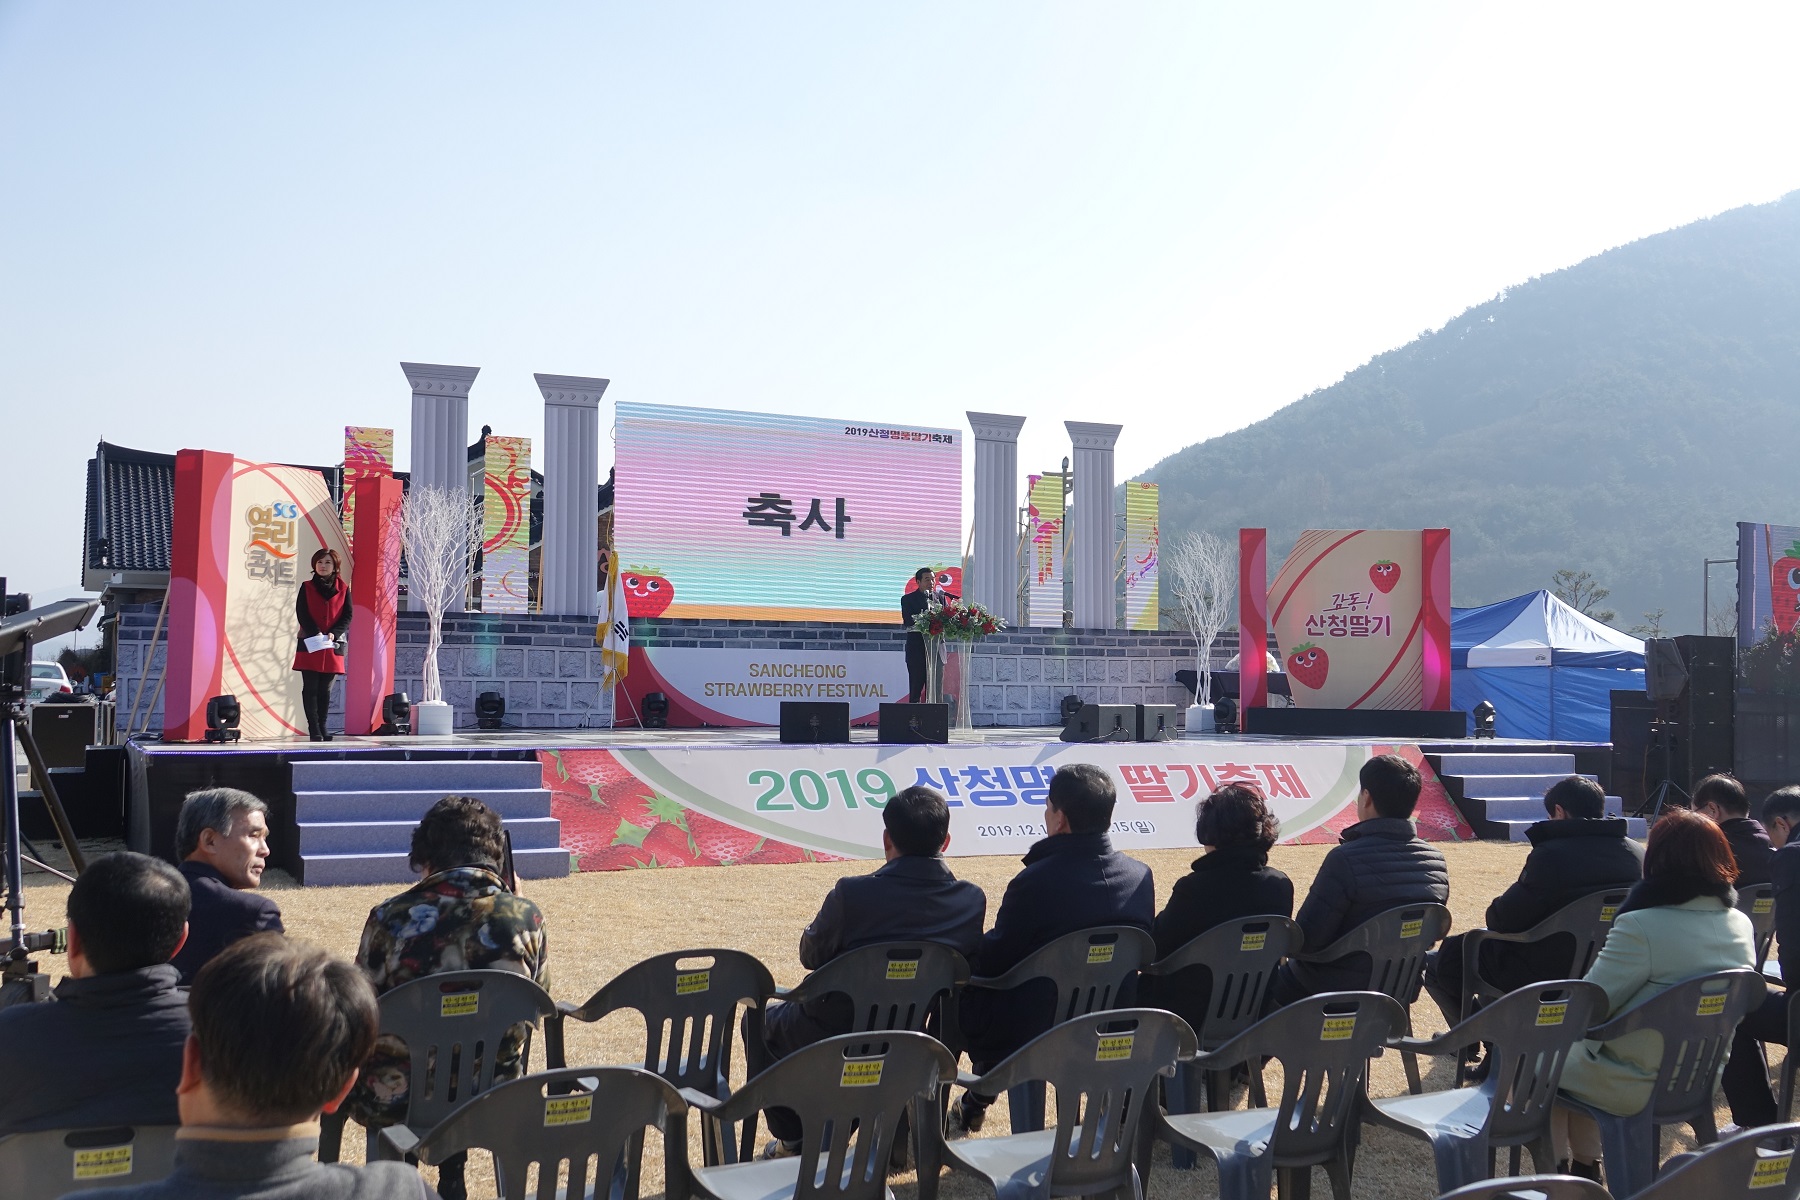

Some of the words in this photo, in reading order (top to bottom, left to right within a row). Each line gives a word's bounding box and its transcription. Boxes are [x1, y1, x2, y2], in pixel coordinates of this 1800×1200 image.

[273, 503, 297, 518] SCS
[742, 492, 852, 538] 축사
[247, 550, 295, 586] 콘서트
[1323, 592, 1373, 612] 감동!
[1305, 614, 1391, 637] 산청딸기
[749, 663, 847, 678] SANCHEONG
[704, 682, 813, 697] STRAWBERRY
[817, 683, 888, 698] FESTIVAL
[748, 769, 897, 811] 2019
[912, 766, 1056, 807] 산청명
[978, 824, 1048, 837] 2019.12.1
[1110, 821, 1156, 834] .15(일)
